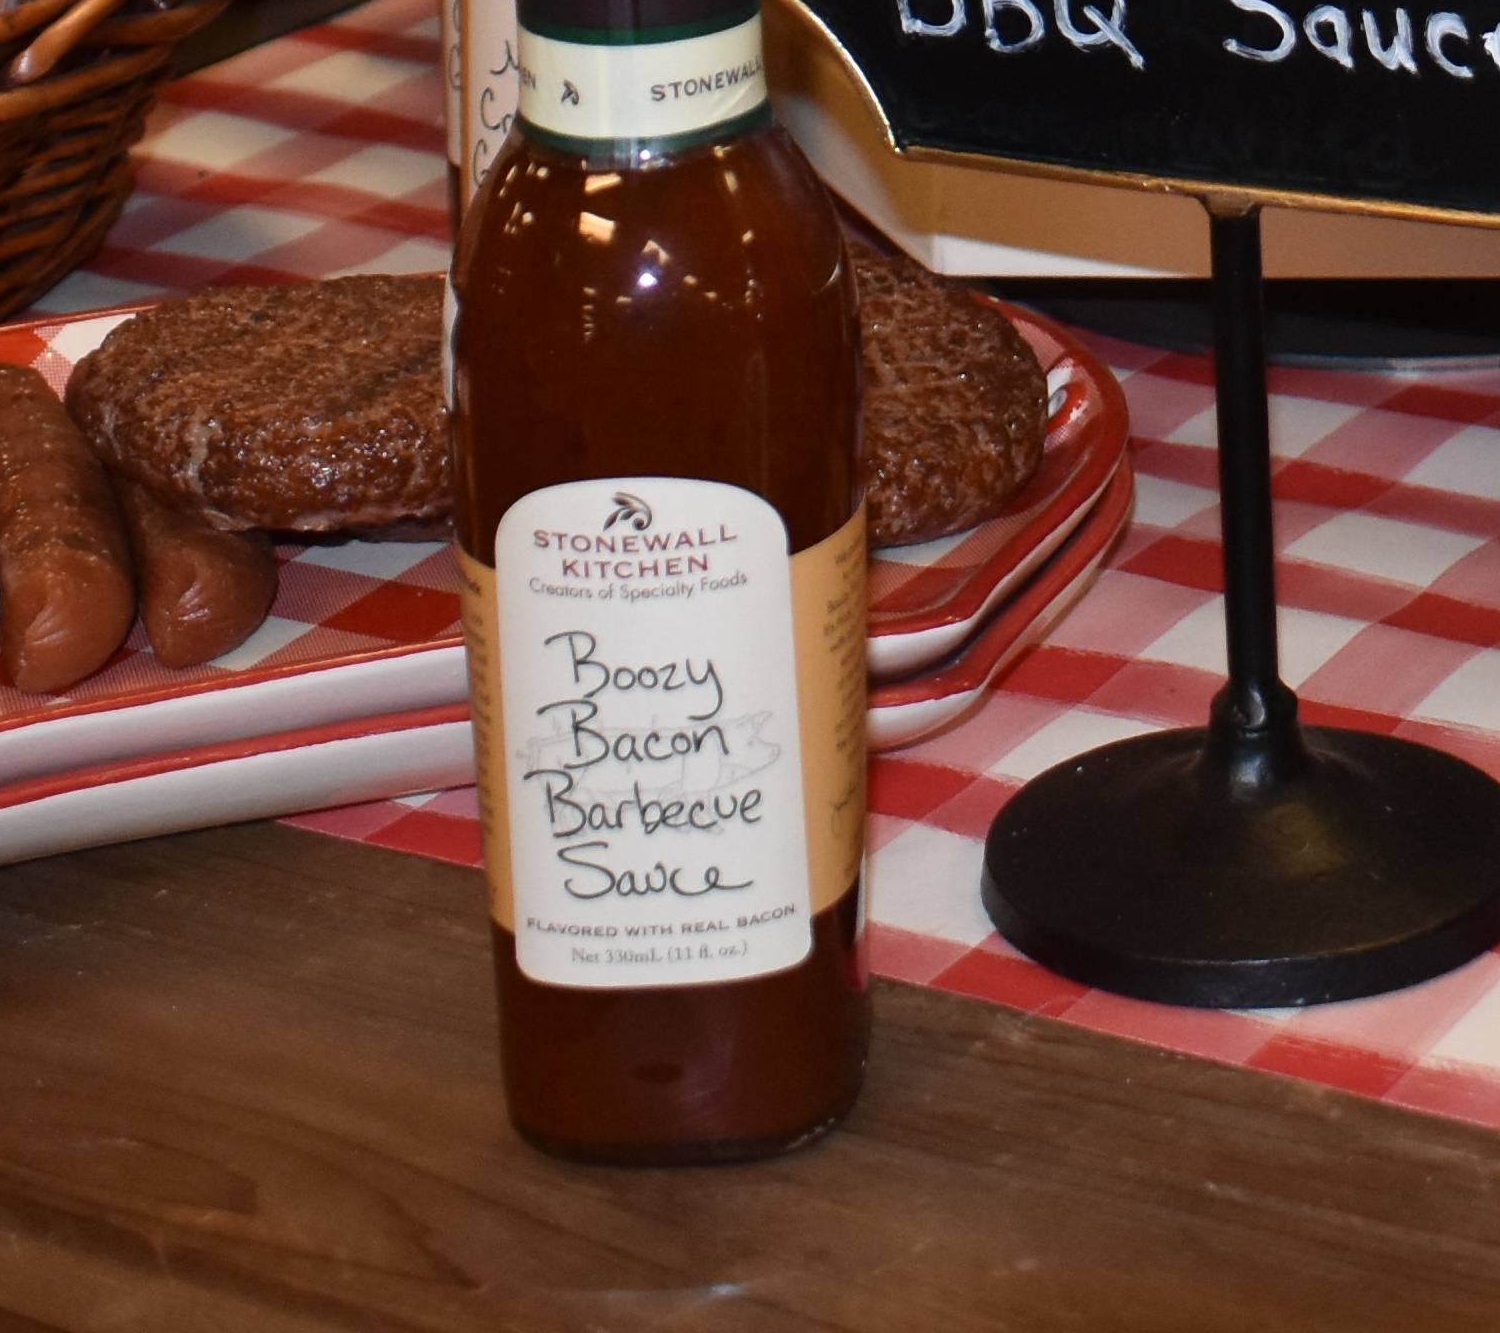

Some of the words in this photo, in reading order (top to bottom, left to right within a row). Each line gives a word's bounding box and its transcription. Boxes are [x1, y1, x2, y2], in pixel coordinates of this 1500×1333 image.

[532, 524, 738, 554] STONEWALL
[529, 576, 594, 600] Creators
[599, 581, 614, 599] of
[620, 577, 694, 601] Specialty
[700, 571, 747, 592] Foods
[561, 553, 710, 580] KITCHEN
[544, 630, 723, 720] Boozy
[536, 698, 730, 769] Bacon
[523, 768, 763, 838] Barbecue
[557, 842, 753, 900] Sauce
[526, 916, 618, 938] FLAVORED
[624, 922, 675, 937] WITH
[681, 917, 729, 934] REAL
[736, 902, 798, 929] BACON
